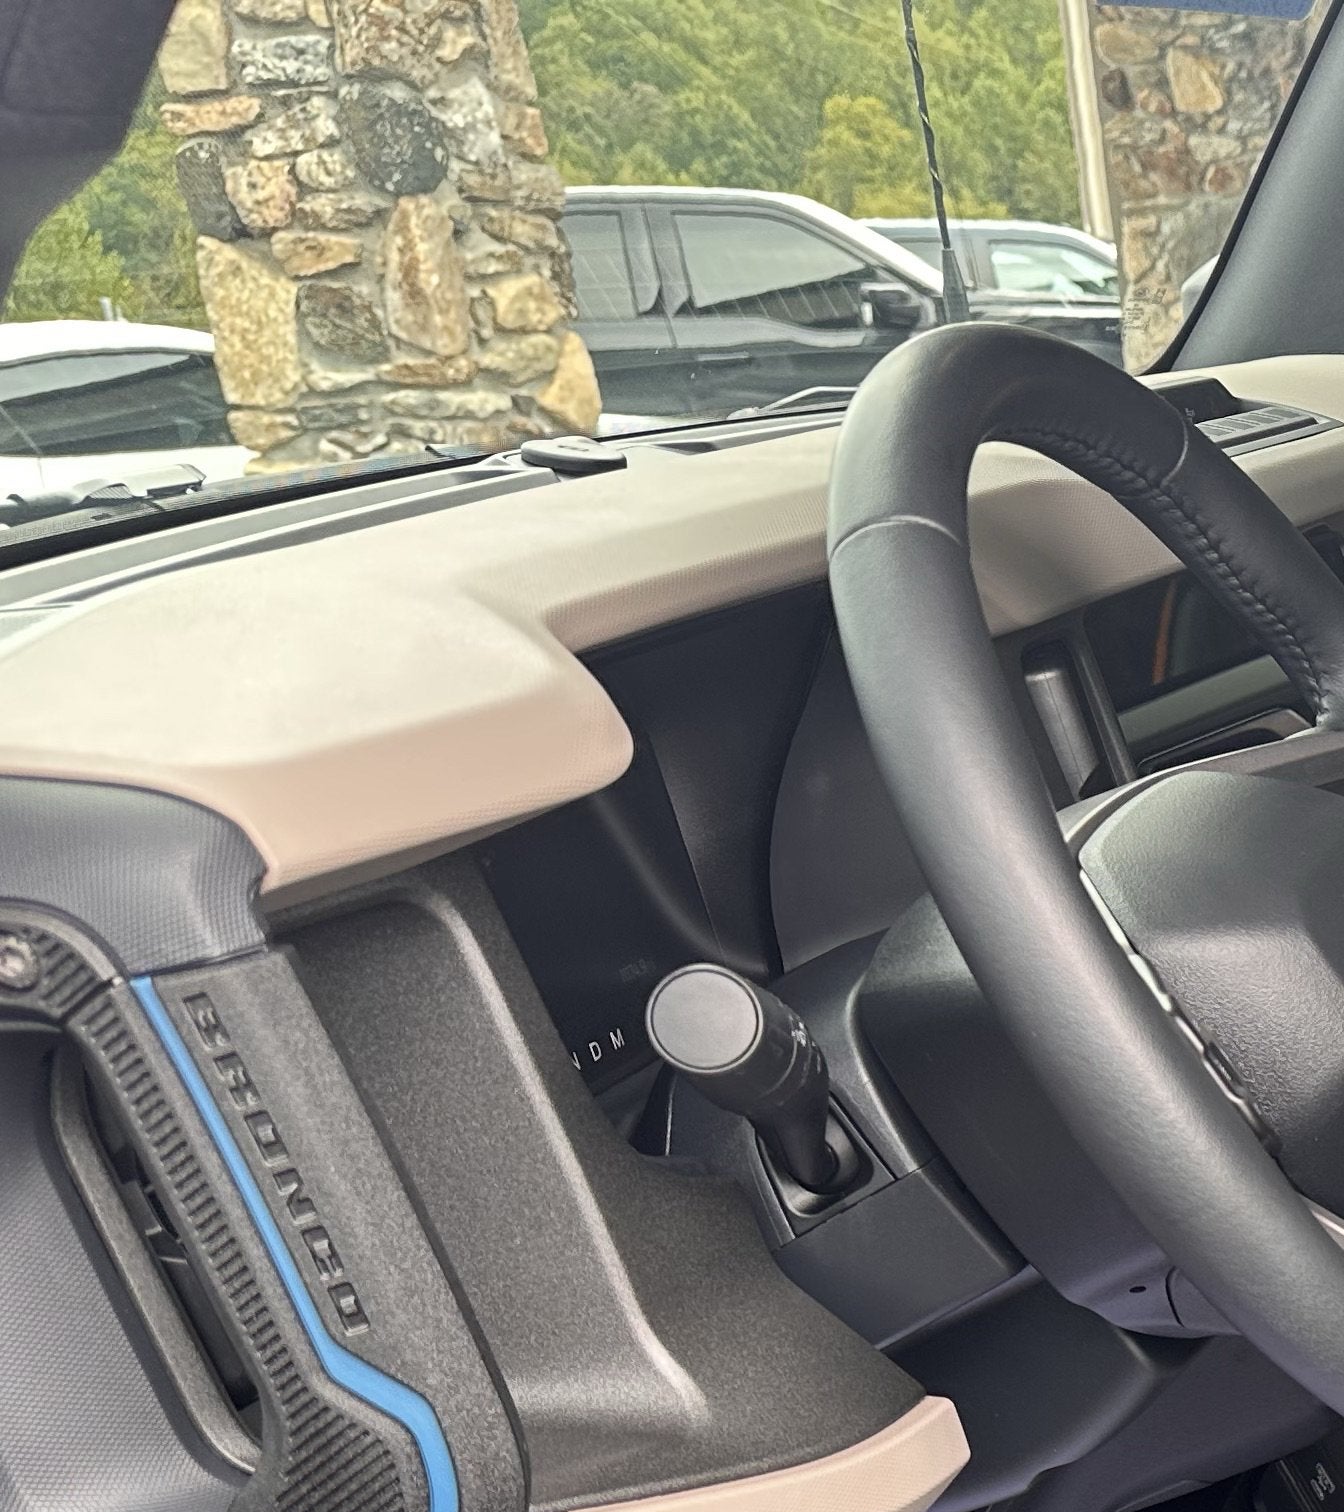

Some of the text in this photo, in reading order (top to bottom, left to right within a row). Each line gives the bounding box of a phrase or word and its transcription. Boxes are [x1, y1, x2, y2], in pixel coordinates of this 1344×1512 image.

[588, 1041, 602, 1062] D
[609, 1028, 625, 1051] M
[182, 991, 370, 1336] BRONCO
